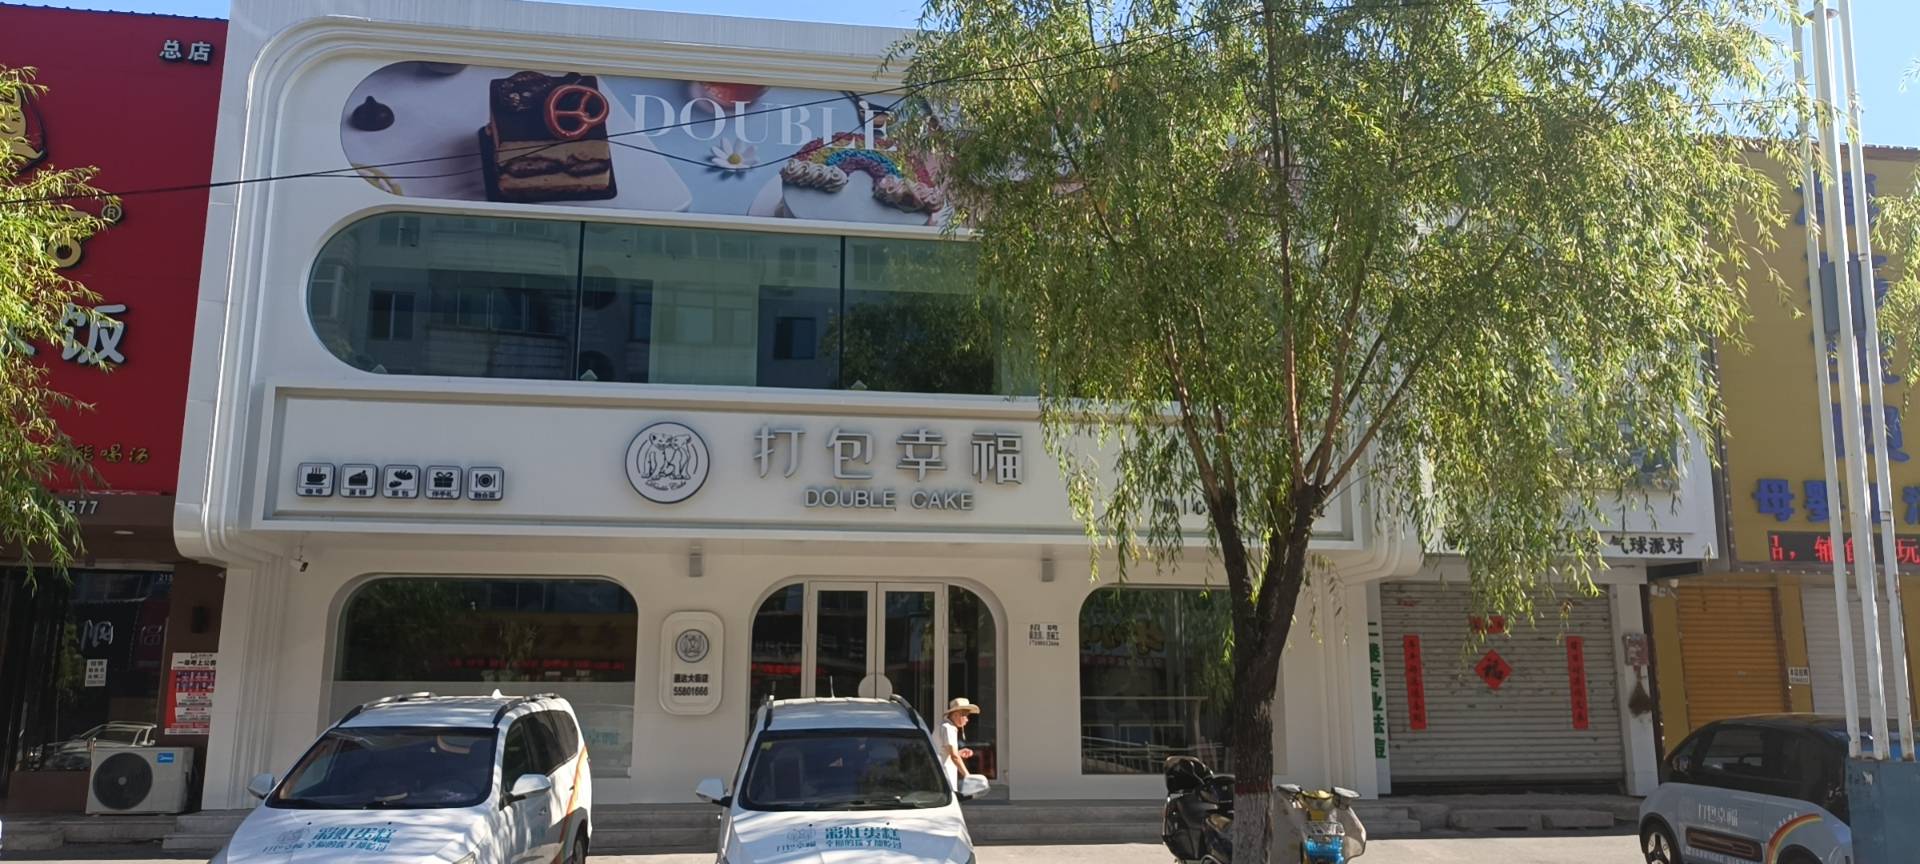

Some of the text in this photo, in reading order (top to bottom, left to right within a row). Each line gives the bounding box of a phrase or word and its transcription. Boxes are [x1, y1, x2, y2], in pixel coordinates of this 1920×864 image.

[159, 39, 211, 62] 总店
[632, 94, 898, 153] DOUBLE
[753, 424, 1023, 485] 打包幸福
[804, 488, 974, 512] DOUBLE CAKE
[1609, 535, 1684, 555] 气球派对
[825, 826, 901, 841] 彩虹蛋糕
